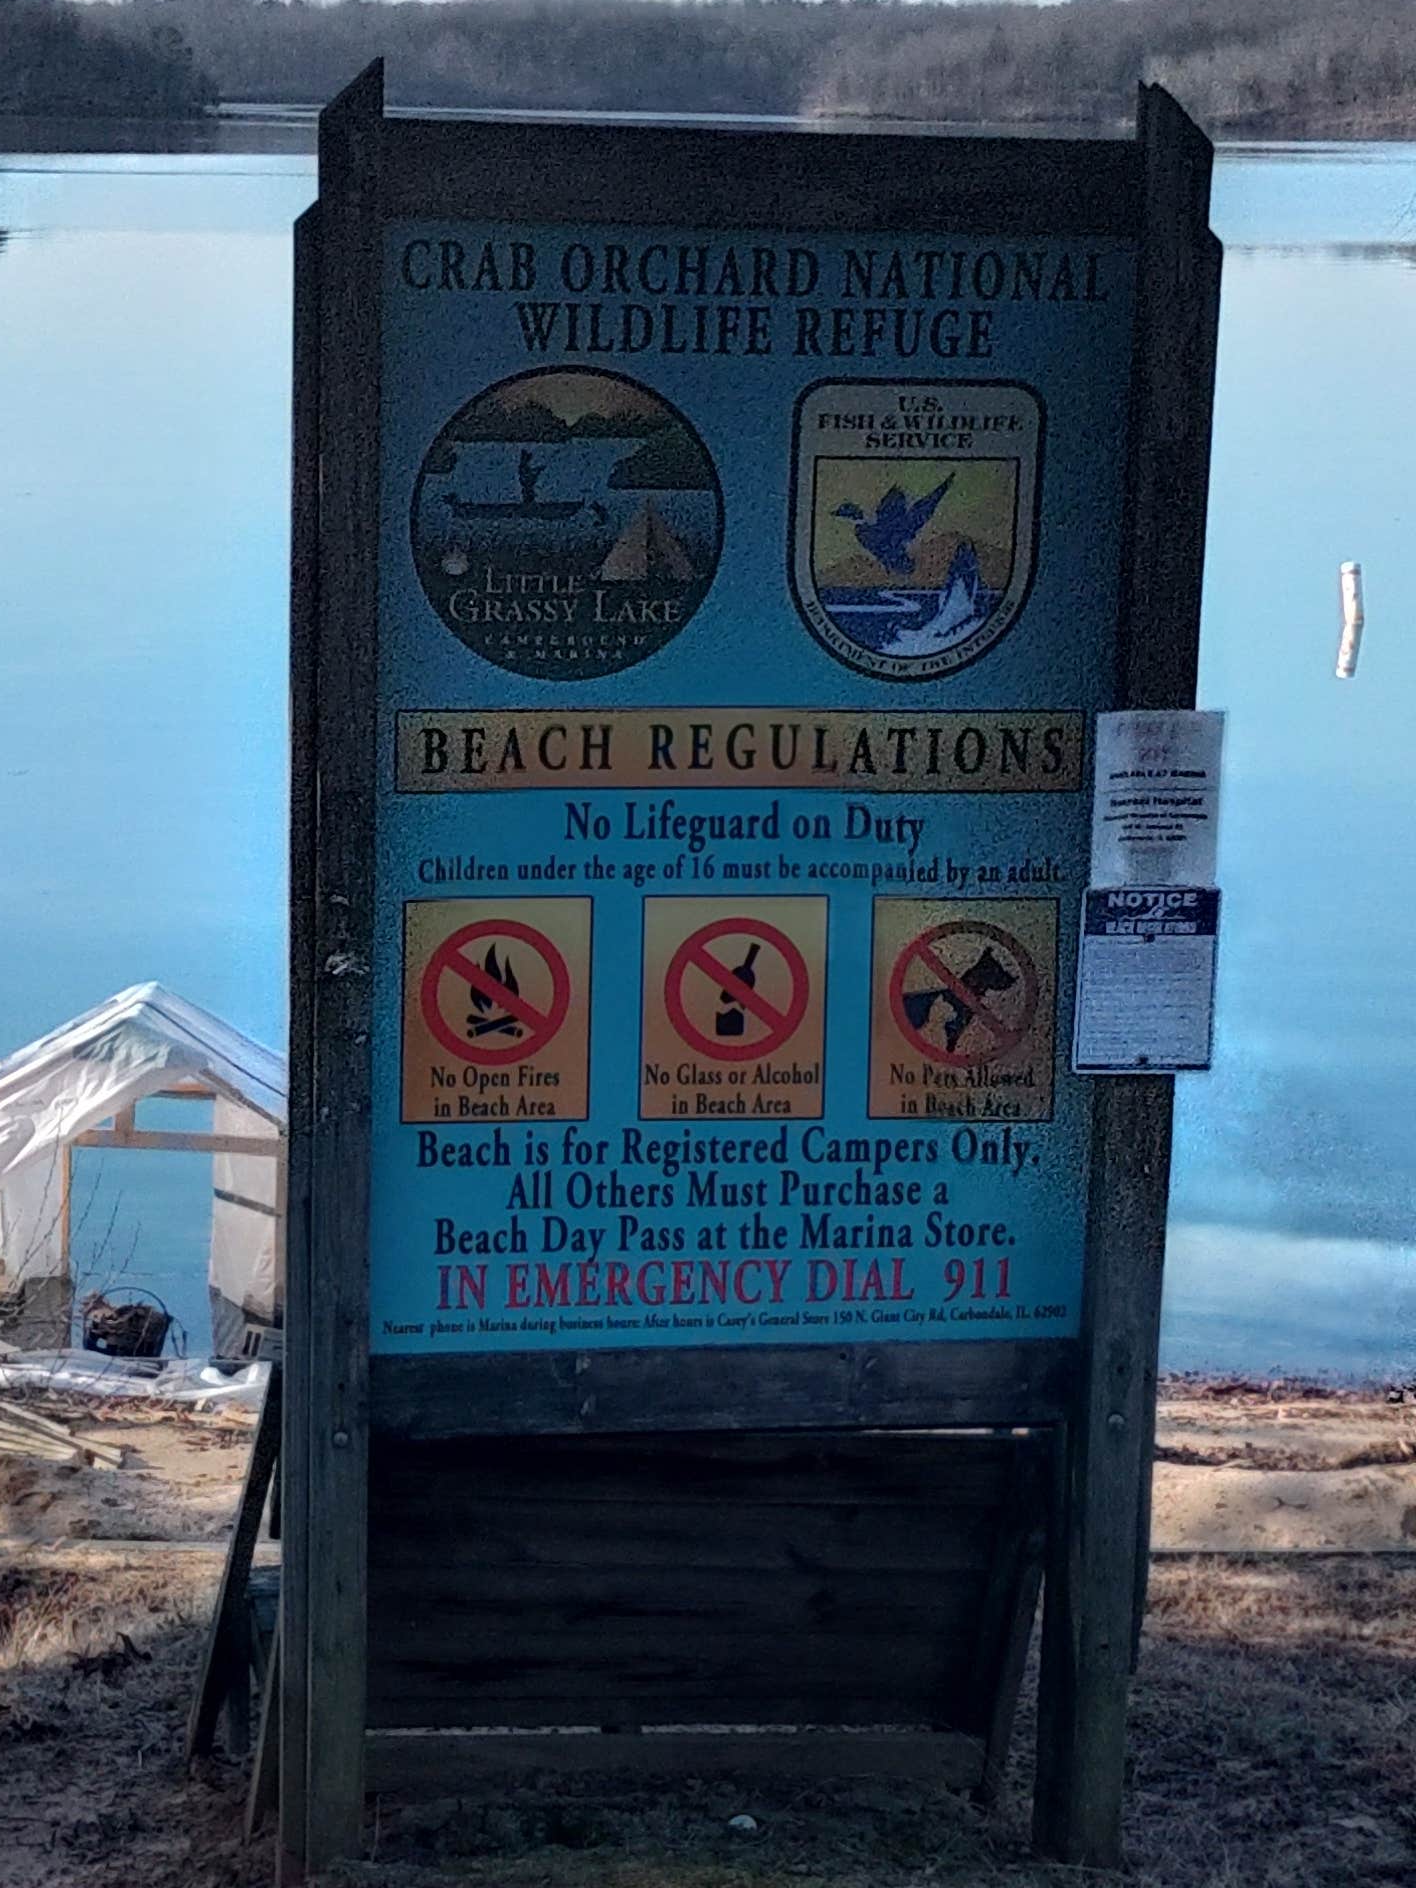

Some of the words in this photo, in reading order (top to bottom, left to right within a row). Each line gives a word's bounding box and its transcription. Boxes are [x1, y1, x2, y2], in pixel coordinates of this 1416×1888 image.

[402, 239, 535, 291] CRAB
[561, 243, 820, 297] ORCHARD
[840, 248, 1109, 301] NATIONAL
[514, 301, 772, 356] WILDLIFE
[792, 307, 994, 358] REFUGE
[818, 413, 874, 430] FISH
[881, 414, 897, 430] &
[903, 414, 1024, 431] WILDLIFE
[865, 433, 974, 449] SERVICE
[449, 589, 578, 623] GRASSY
[592, 589, 683, 623] LAKE
[417, 724, 613, 774] BEACH
[647, 723, 1064, 775] REGULATIONS
[564, 802, 611, 840] No
[624, 799, 780, 853] Lifeguard
[793, 814, 831, 840] on
[844, 802, 925, 855] Duty
[418, 855, 508, 883] Children
[518, 855, 576, 880] under
[584, 855, 615, 880] the
[623, 862, 655, 888] age
[663, 855, 685, 880] of
[691, 855, 714, 880] 16
[723, 858, 771, 880] must
[779, 855, 801, 880] be
[807, 856, 939, 887] accompanied
[946, 855, 969, 889] by
[977, 862, 1000, 883] an
[1107, 892, 1199, 907] NOTICE
[431, 1066, 456, 1088] No
[463, 1066, 509, 1092] Open
[518, 1065, 560, 1088] Fires
[645, 1064, 670, 1086] No
[677, 1063, 722, 1086] Glass
[728, 1070, 747, 1086] or
[752, 1063, 820, 1086] Alcohol
[890, 1063, 915, 1086] No
[922, 1063, 958, 1088] Pets
[965, 1064, 1035, 1089] Allowed
[434, 1097, 451, 1117] in
[458, 1096, 509, 1117] Beach
[517, 1095, 556, 1117] Area
[672, 1094, 689, 1115] in
[696, 1093, 746, 1115] Beach
[753, 1093, 792, 1115] Area
[901, 1094, 918, 1115] in
[926, 1094, 976, 1116] Beach
[982, 1095, 1020, 1117] Area
[417, 1127, 511, 1168] Beach
[524, 1130, 549, 1166] is
[562, 1126, 609, 1165] for
[621, 1125, 788, 1178] Registered
[801, 1126, 938, 1175] Campers
[951, 1126, 1040, 1177] Only.
[506, 1169, 552, 1210] All
[566, 1169, 674, 1209] Others
[685, 1170, 767, 1207] Must
[779, 1168, 922, 1207] Purchase
[934, 1180, 949, 1205] a
[434, 1214, 528, 1255] Beach
[541, 1215, 606, 1262] Day
[618, 1214, 685, 1252] Pass
[697, 1222, 726, 1251] at
[739, 1212, 788, 1250] the
[799, 1213, 913, 1250] Marina
[925, 1211, 1016, 1247] Store.
[436, 1264, 488, 1310] IN
[504, 1259, 792, 1309] EMERGENCY
[805, 1257, 915, 1303] DIAL
[944, 1256, 1011, 1303] 911
[382, 1320, 424, 1335] Nearest
[430, 1319, 463, 1337] phone
[467, 1319, 476, 1332] is
[479, 1317, 517, 1333] Marina
[520, 1316, 556, 1334] during
[559, 1316, 604, 1331] business
[644, 1313, 669, 1329] After
[673, 1313, 702, 1328] hours
[706, 1314, 715, 1327] is
[717, 1313, 756, 1330] Casey's
[758, 1311, 799, 1326] General
[834, 1310, 852, 1324] 150
[871, 1309, 900, 1323] Giant
[903, 1309, 925, 1326] City
